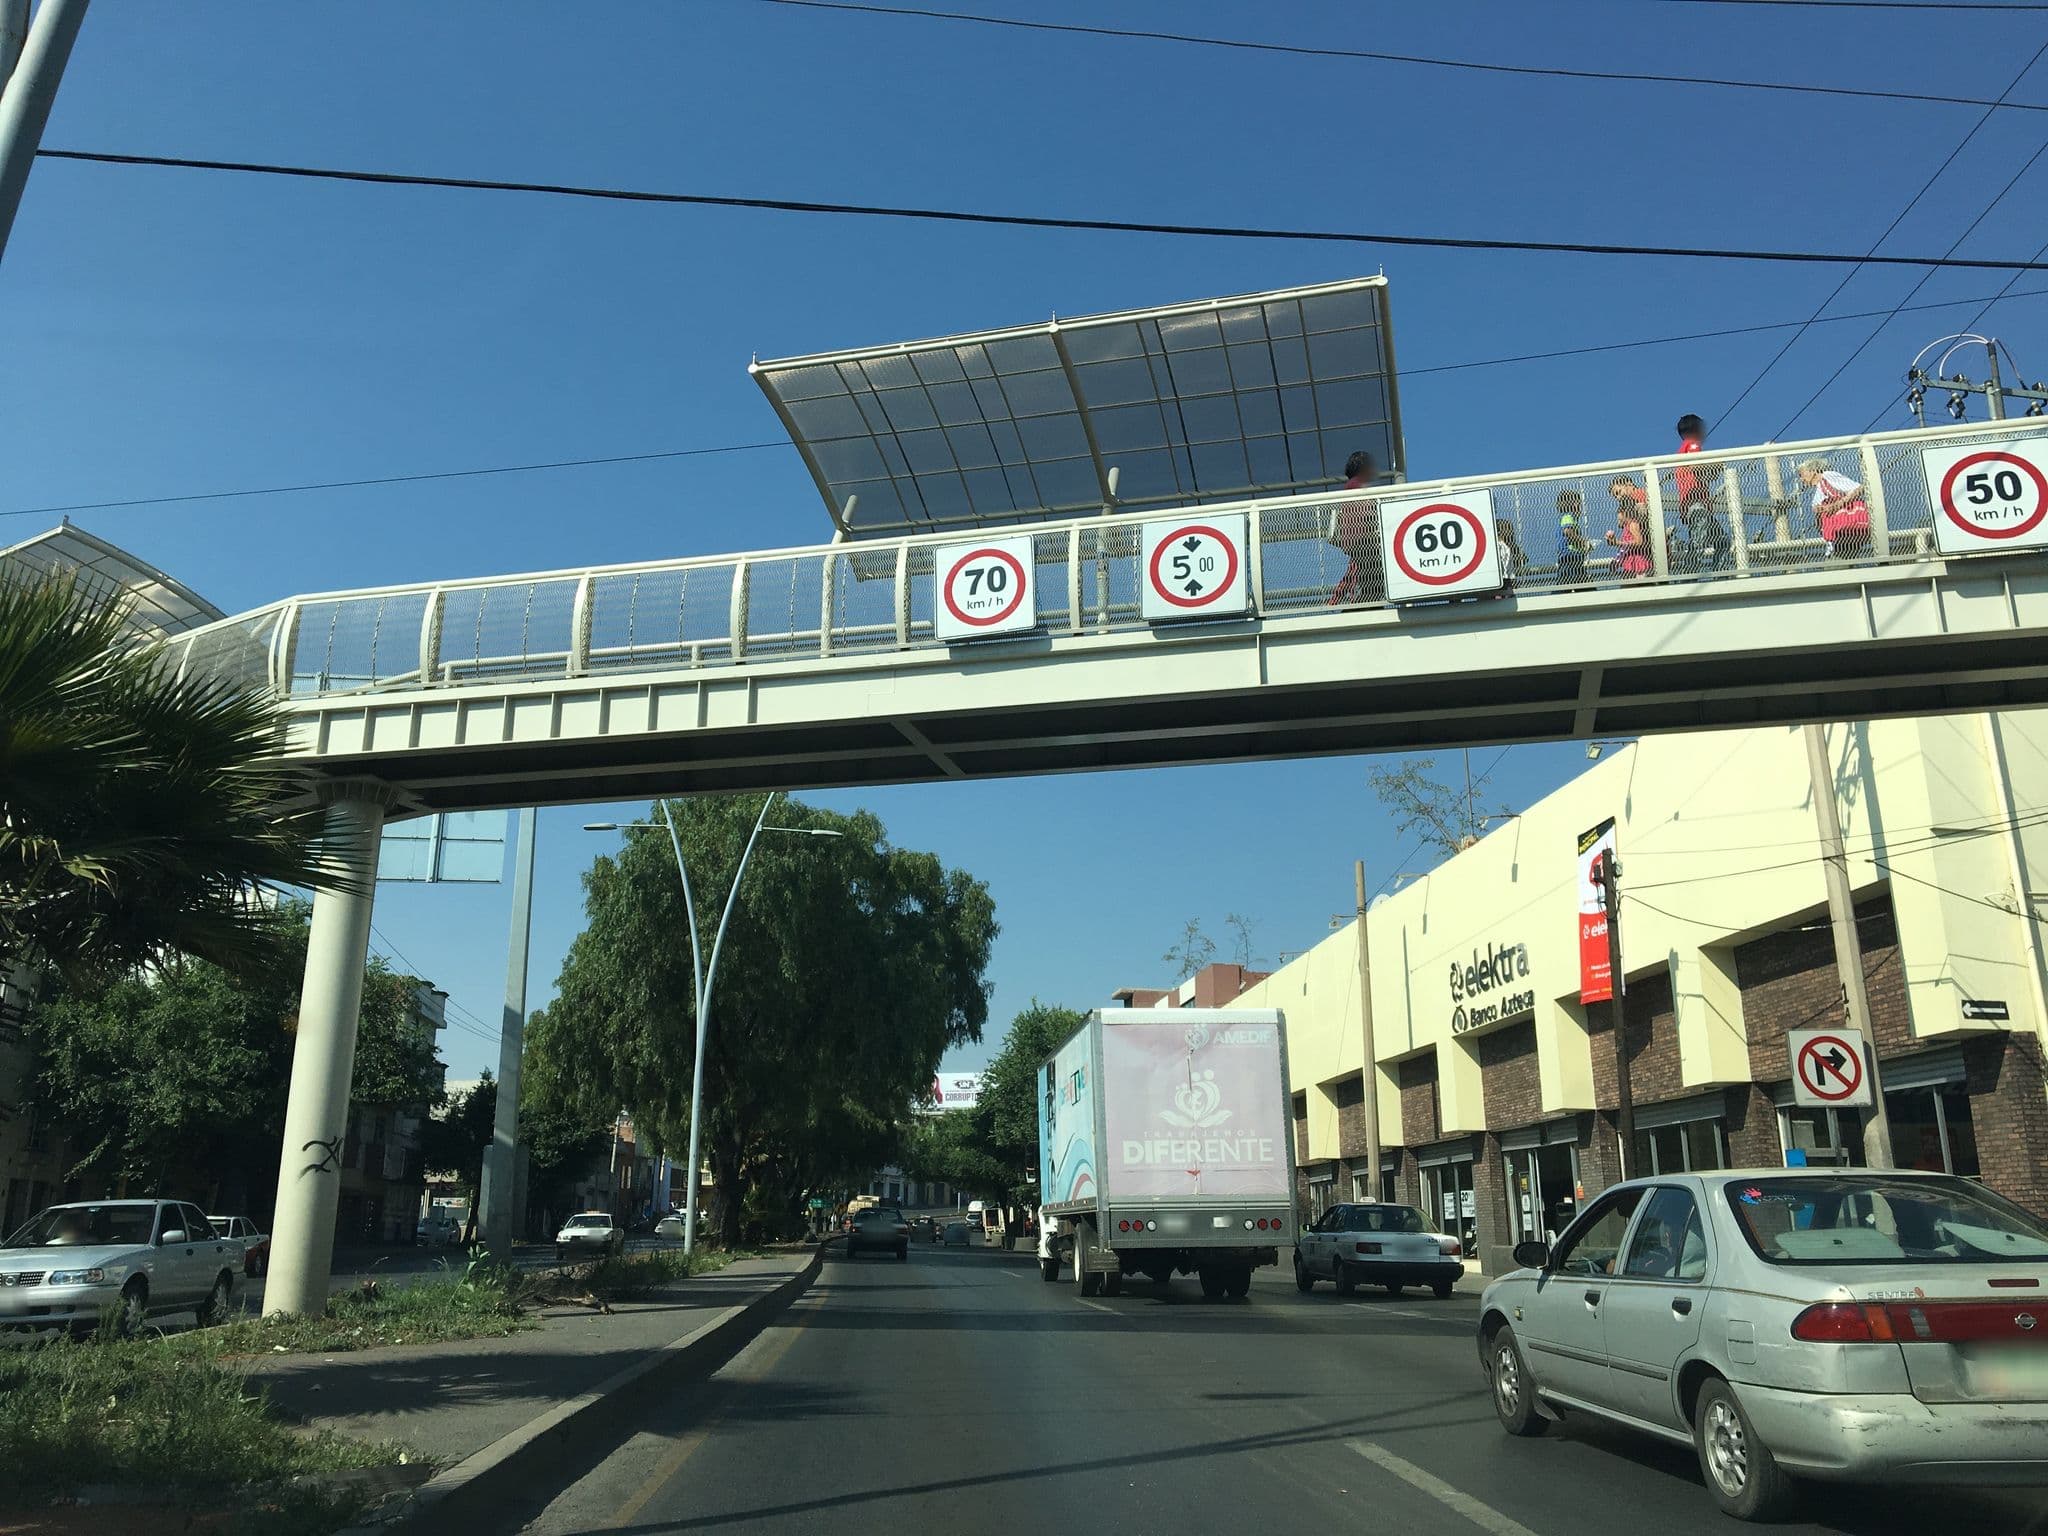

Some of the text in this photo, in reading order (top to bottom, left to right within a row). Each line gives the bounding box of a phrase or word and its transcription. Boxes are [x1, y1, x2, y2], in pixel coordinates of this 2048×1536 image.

[1966, 470, 2023, 505] 50
[1415, 520, 1463, 553] 60
[965, 565, 1007, 596] 70
[1173, 555, 1214, 580] 5 00
[1465, 941, 1531, 998] elektra
[1470, 989, 1535, 1028] Banco Azteca
[1122, 1138, 1275, 1165] DIFERENTE
